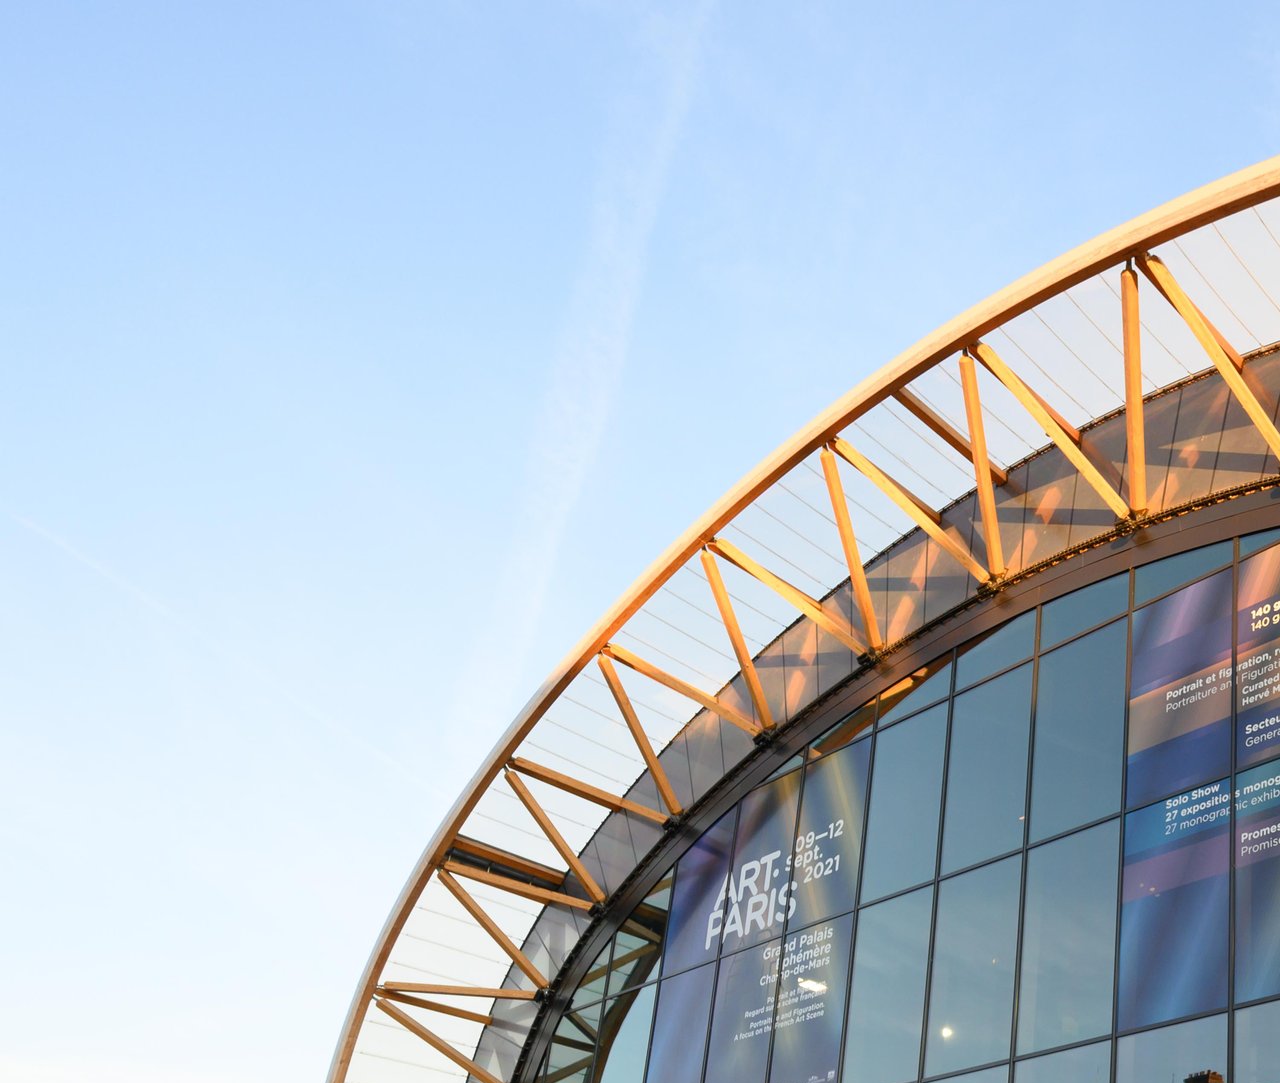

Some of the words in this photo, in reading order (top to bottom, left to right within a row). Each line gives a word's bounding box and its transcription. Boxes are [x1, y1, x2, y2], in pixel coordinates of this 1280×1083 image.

[1251, 604, 1270, 619] 140
[1251, 617, 1269, 631] 140
[1167, 679, 1203, 700] Portrait
[1206, 672, 1216, 684] et
[1219, 653, 1272, 679] figration,
[1242, 676, 1279, 694] Curated
[1166, 687, 1217, 712] Portraiture
[1220, 676, 1238, 691] an
[1242, 688, 1269, 706] Hervé
[1166, 795, 1188, 809] Solo
[1192, 784, 1220, 799] Show
[1166, 811, 1177, 822] 27
[1165, 824, 1176, 835] 27
[785, 845, 823, 873] sept.
[803, 855, 840, 884] 2021
[705, 880, 798, 950] PARIS
[800, 927, 833, 948] Palais
[740, 1031, 754, 1039] focus
[775, 1018, 795, 1028] French
[795, 1015, 805, 1023] Art
[806, 1010, 824, 1020] Scene
[781, 1011, 791, 1019] and
